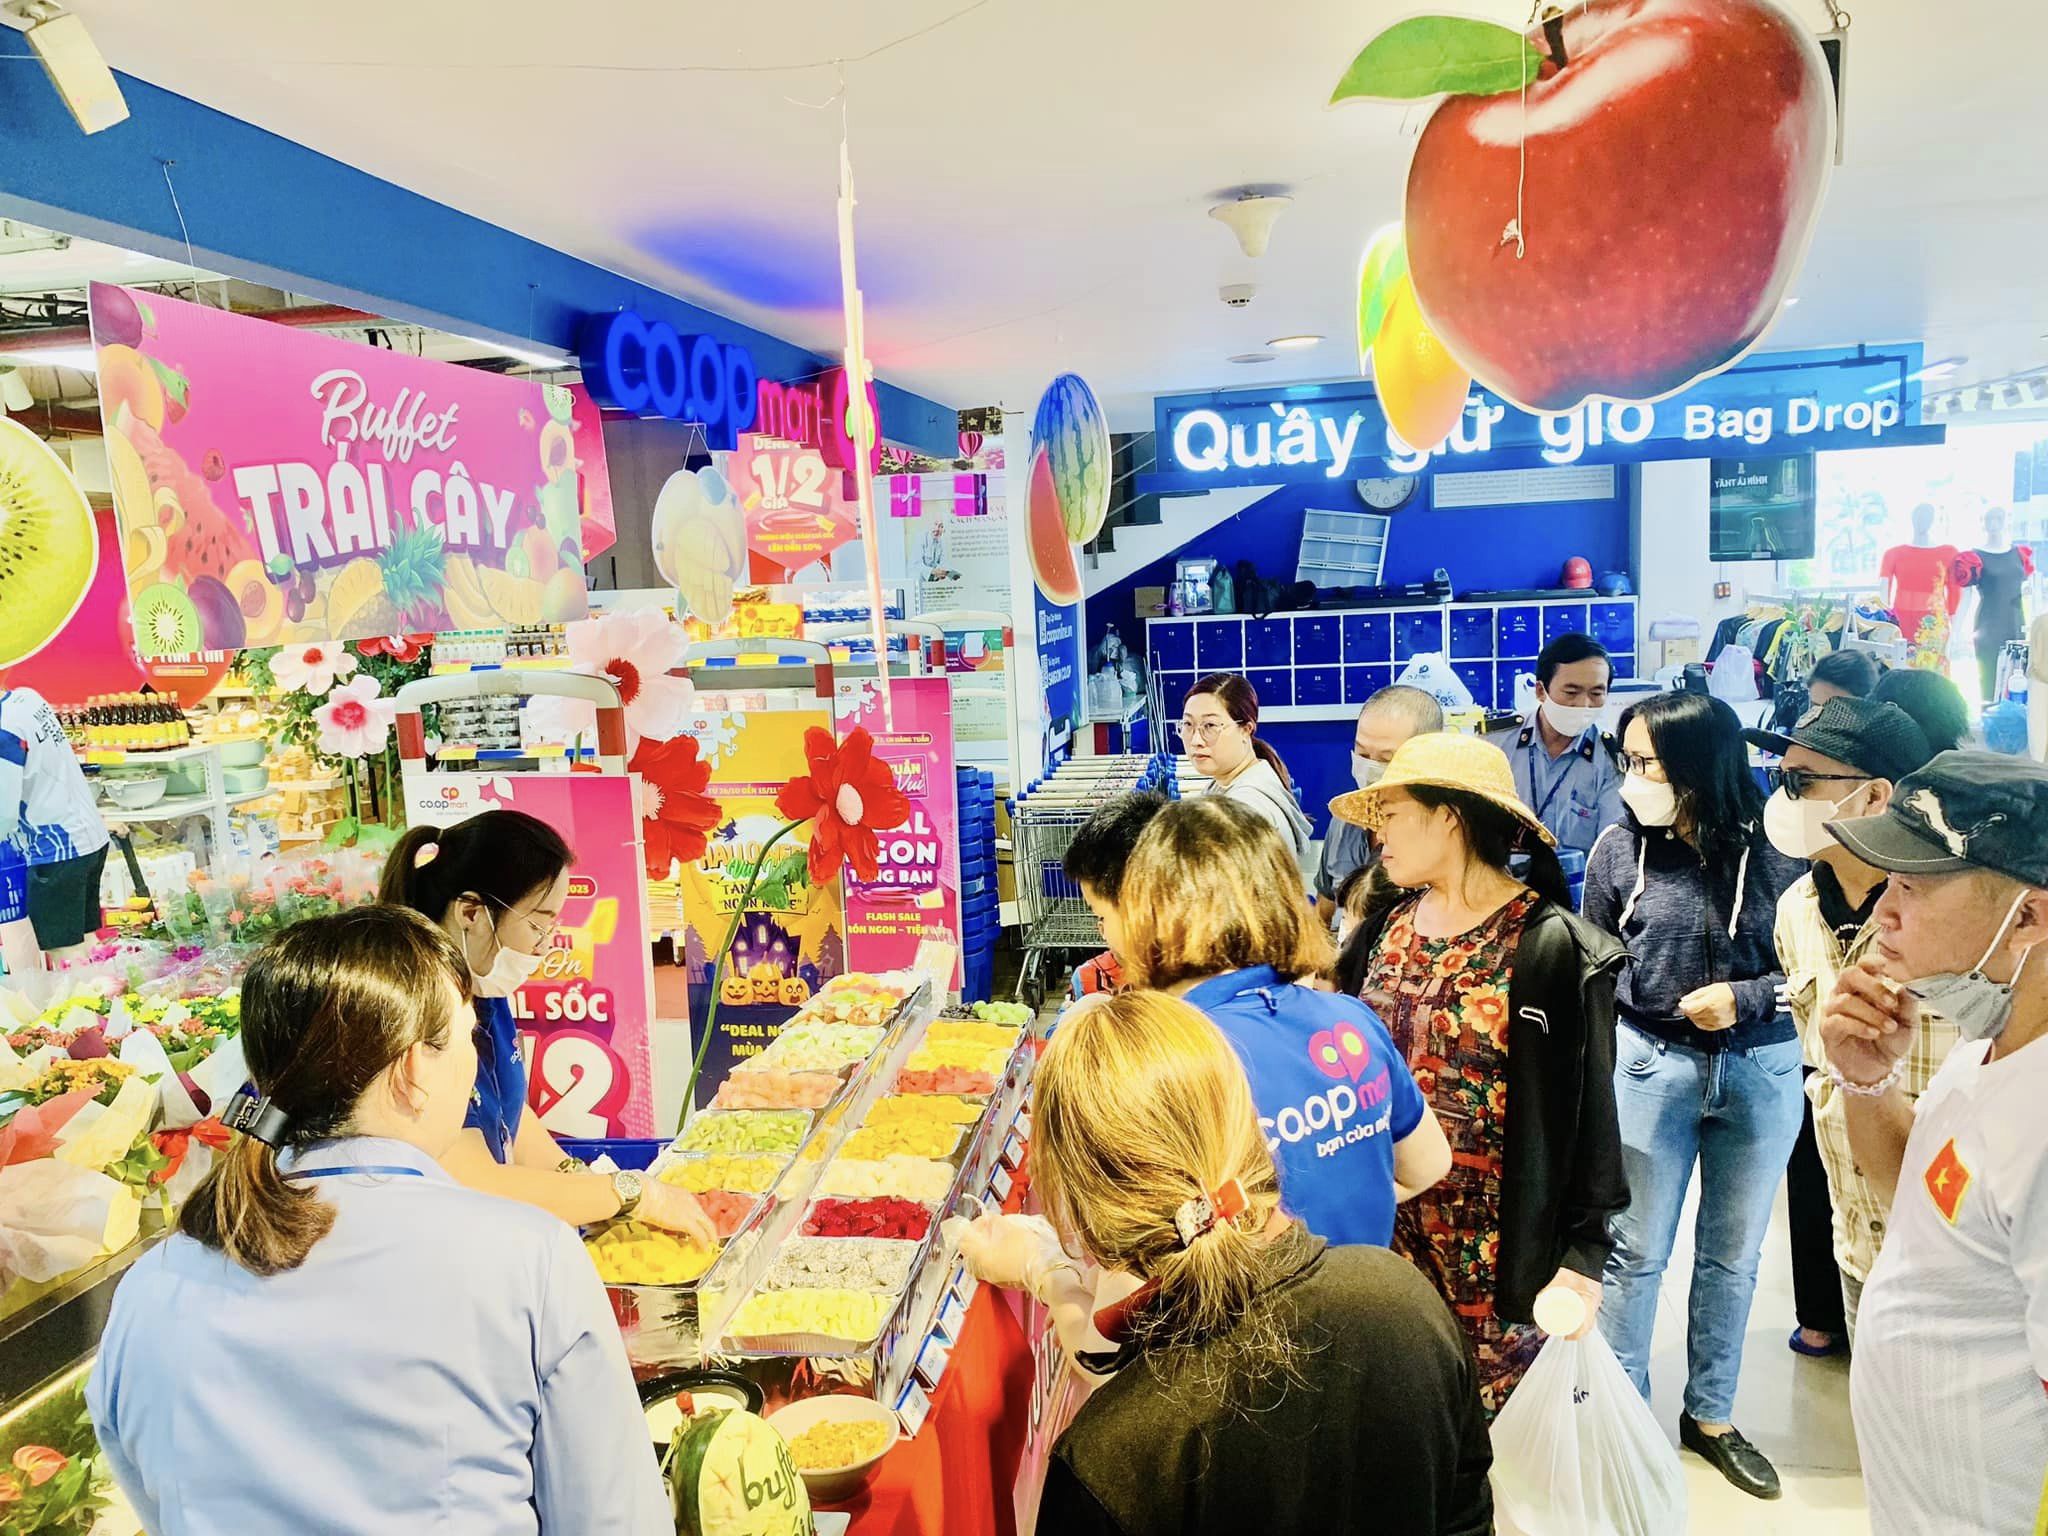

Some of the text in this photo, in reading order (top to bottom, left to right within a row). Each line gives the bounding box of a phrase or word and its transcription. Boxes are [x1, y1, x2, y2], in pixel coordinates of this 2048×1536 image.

[311, 368, 459, 462] Buffet
[1173, 402, 1362, 478] Quầy
[1683, 404, 1773, 444] Bag
[1787, 396, 1899, 436] Drop
[232, 441, 515, 572] TRÁI CÂY
[566, 884, 590, 894] 023
[898, 869, 933, 886] BẠN
[866, 912, 921, 921] FLASH SALE
[868, 925, 897, 934] NGON
[545, 983, 608, 1021] SỐC
[720, 1024, 764, 1037] “DEAL
[1316, 1122, 1374, 1158] bạn của
